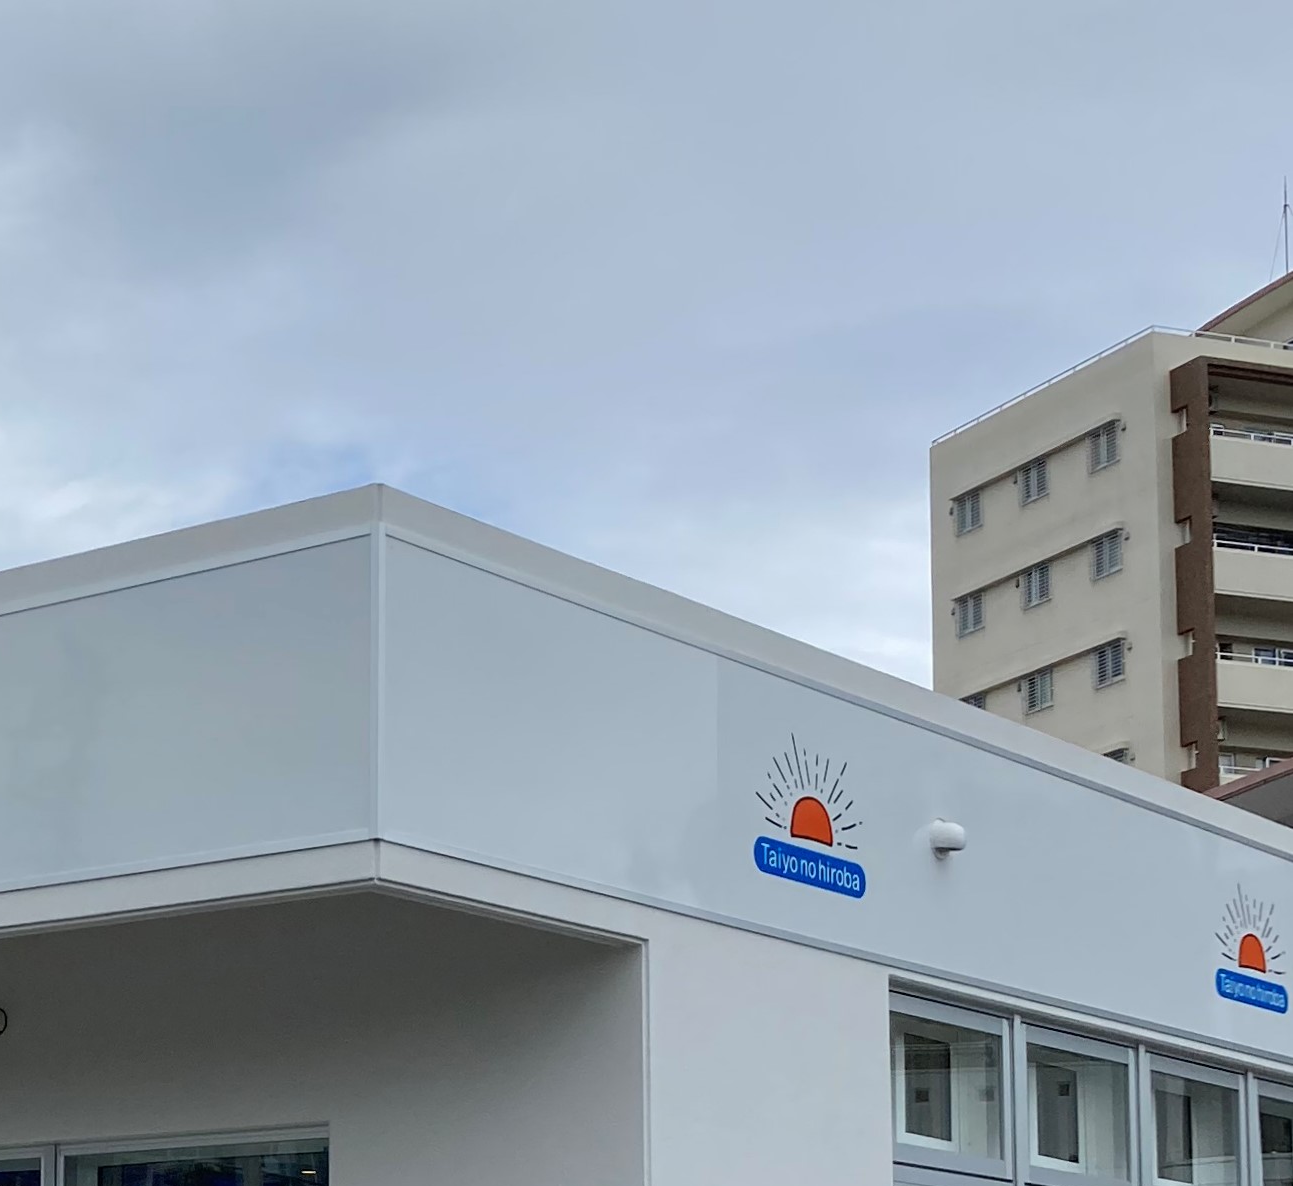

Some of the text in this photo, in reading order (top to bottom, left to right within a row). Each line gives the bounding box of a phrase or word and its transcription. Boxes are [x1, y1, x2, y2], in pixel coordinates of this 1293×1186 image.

[760, 842, 860, 892] Taiyo no hiroba
